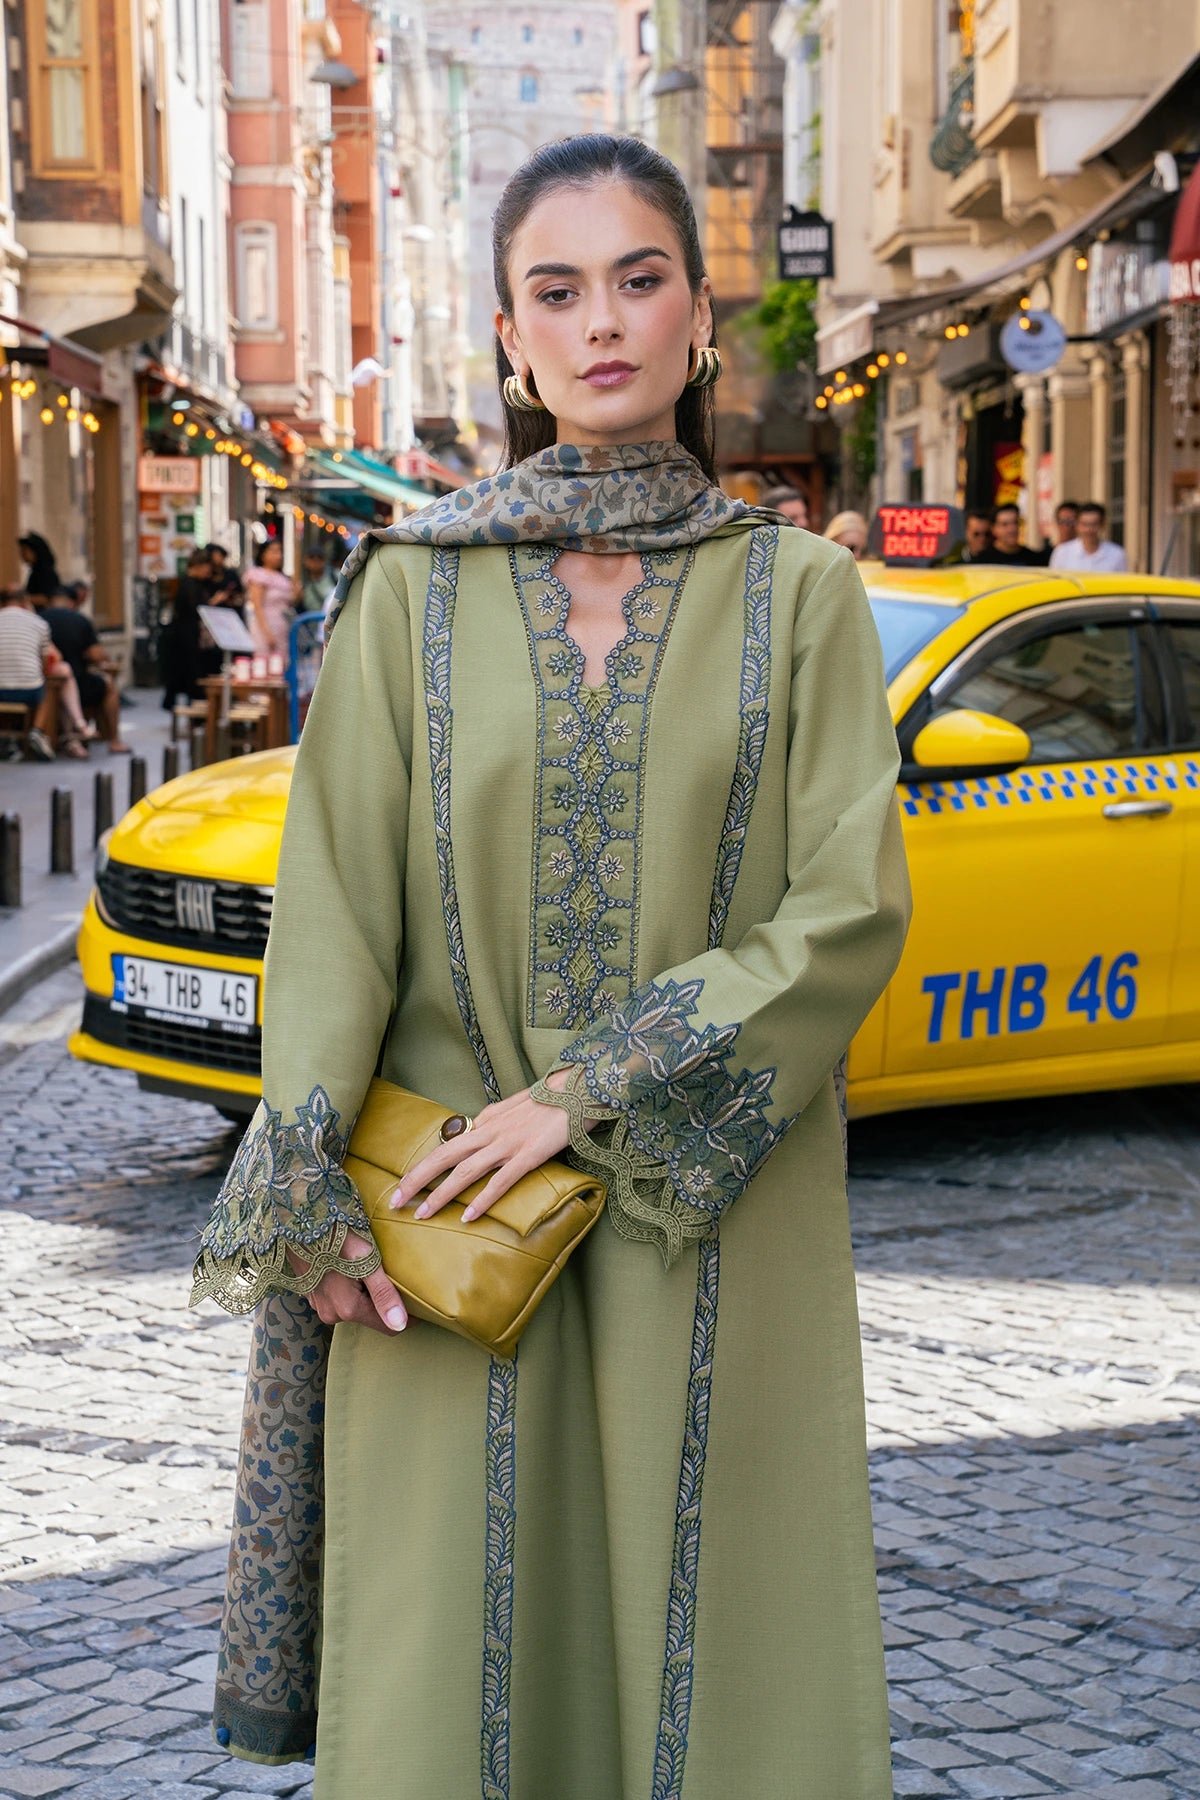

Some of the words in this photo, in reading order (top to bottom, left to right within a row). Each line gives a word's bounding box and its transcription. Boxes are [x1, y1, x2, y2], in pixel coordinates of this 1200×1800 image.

[176, 881, 216, 933] FIAT
[126, 964, 149, 1000] 34
[164, 970, 201, 1009] THB
[220, 979, 247, 1017] 46
[921, 962, 1048, 1044] THB
[1066, 951, 1139, 1023] 46
